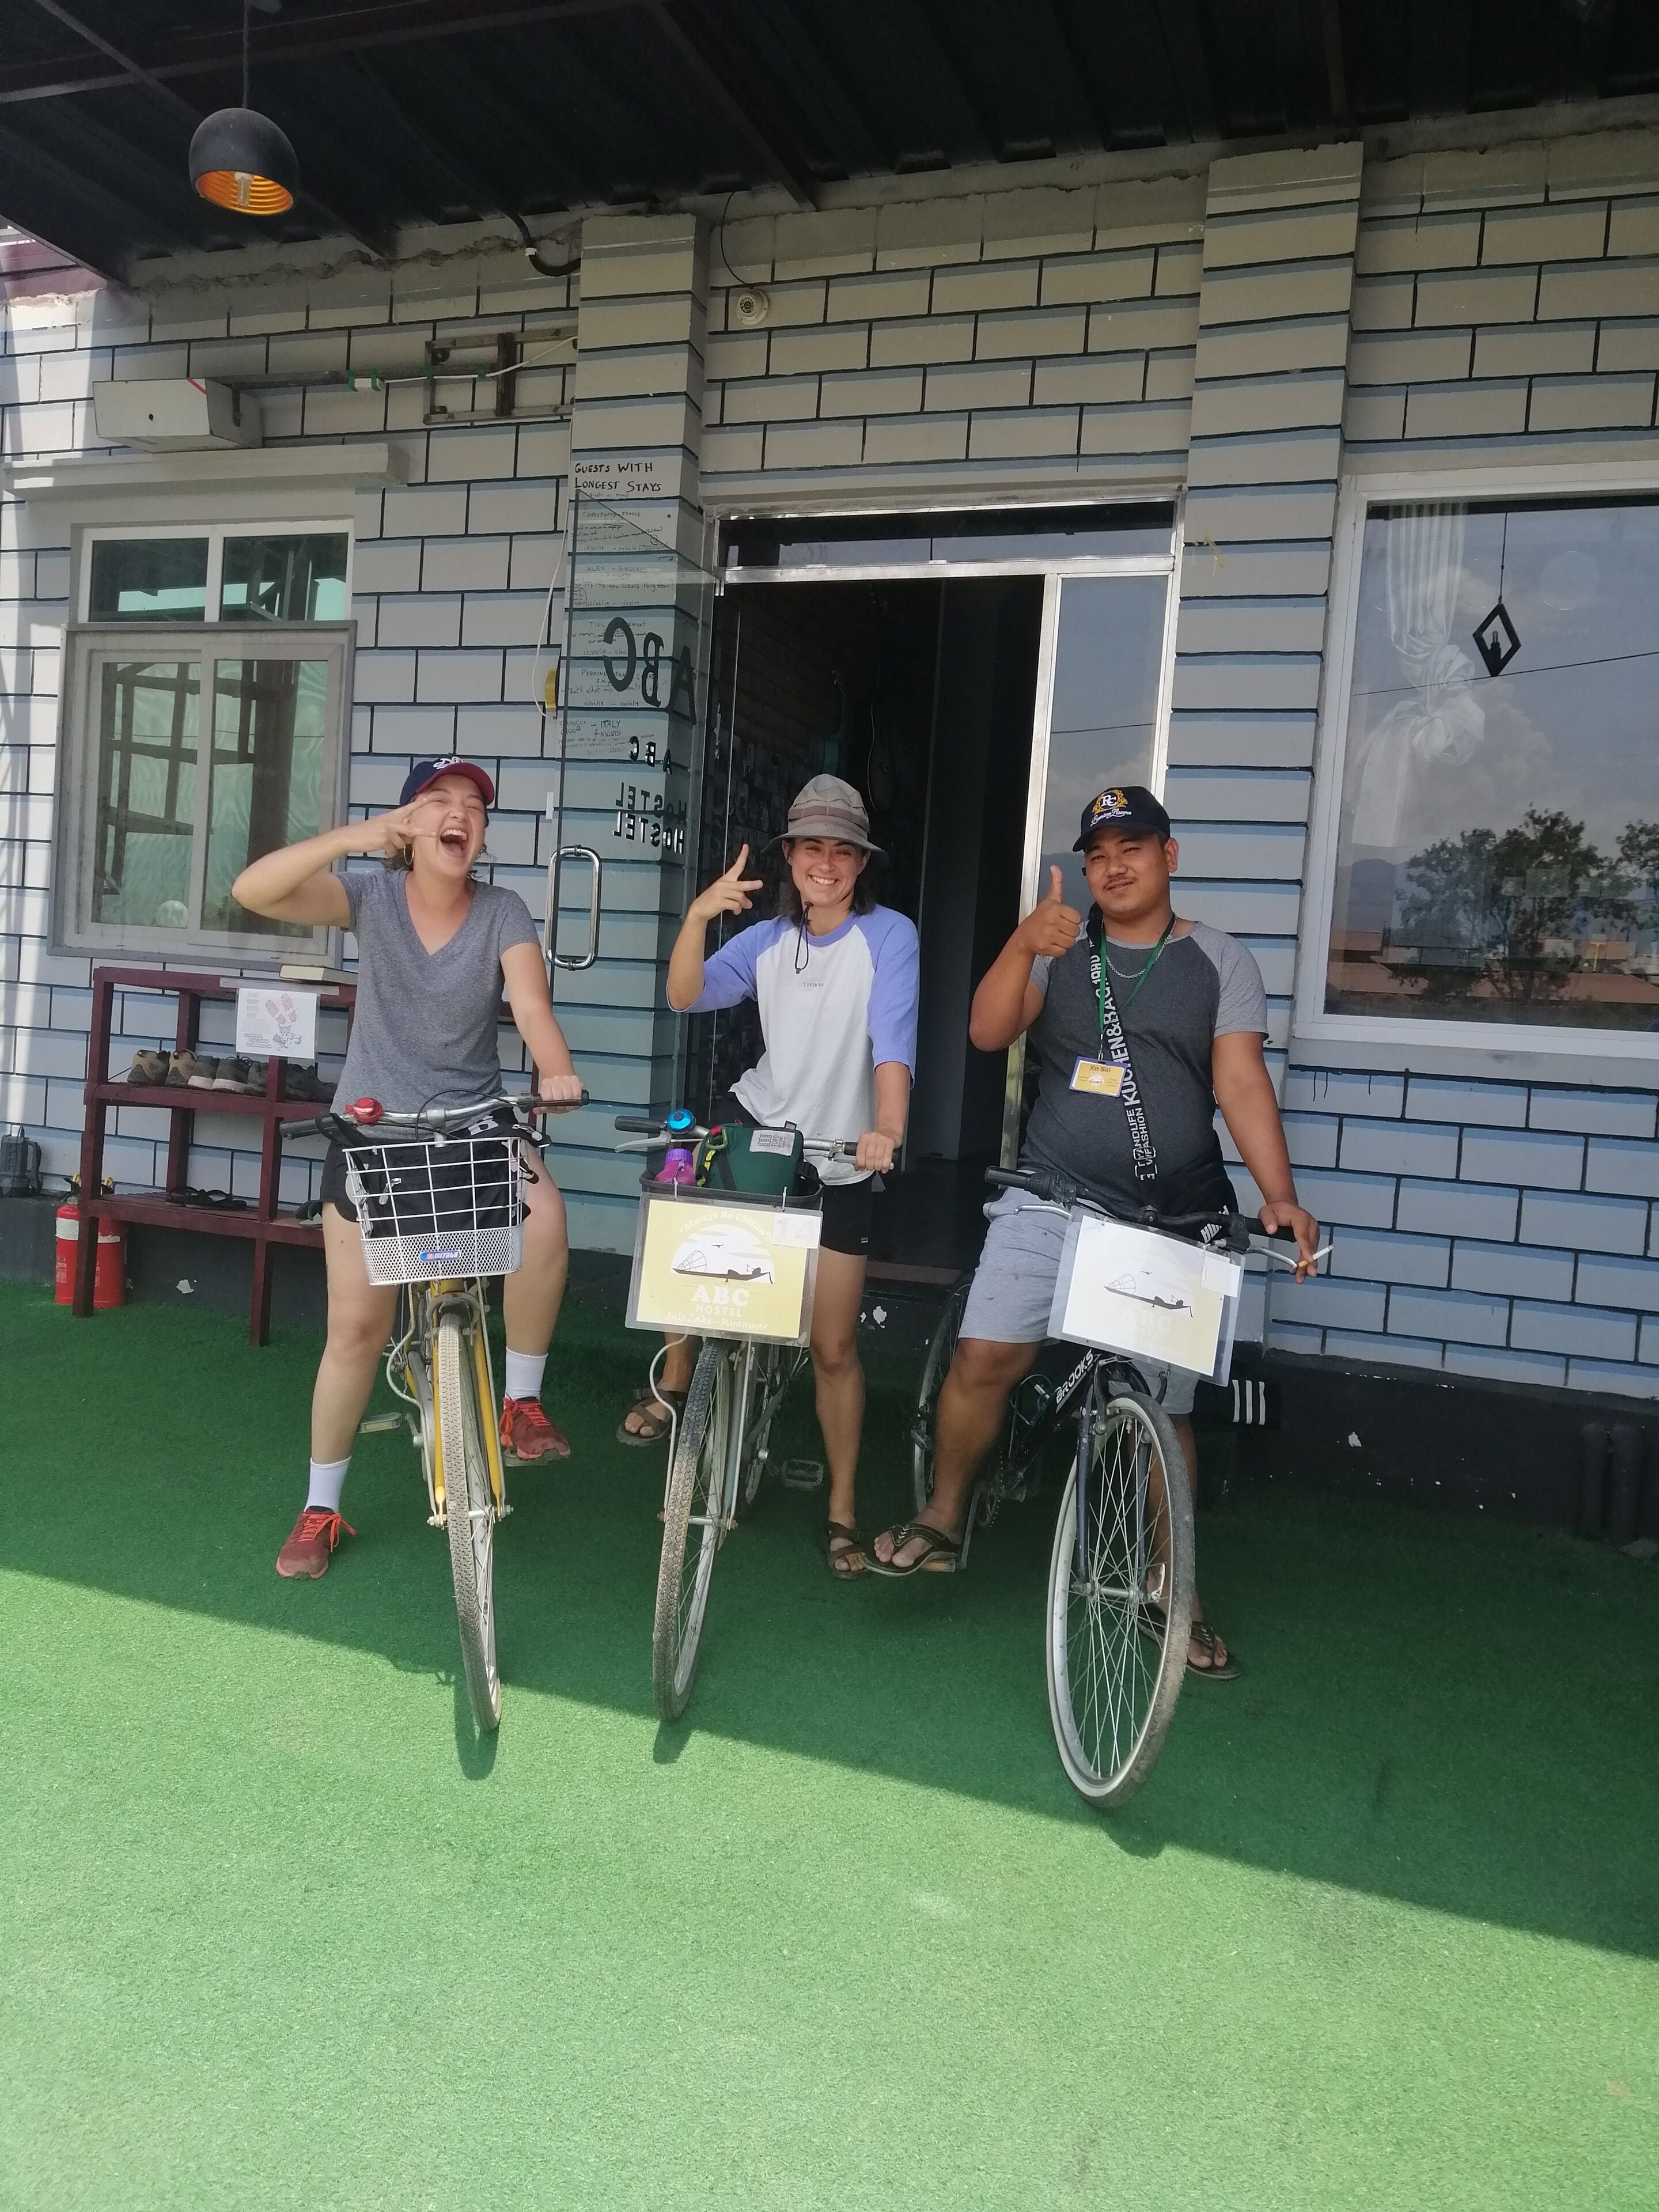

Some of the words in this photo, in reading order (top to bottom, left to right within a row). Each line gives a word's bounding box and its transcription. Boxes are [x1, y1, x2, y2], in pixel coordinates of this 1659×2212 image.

[618, 462, 653, 473] WITH
[574, 477, 620, 490] LONGEST
[627, 480, 662, 493] STAYS
[600, 719, 622, 729] ITALY
[771, 1135, 779, 1147] TOPO
[721, 1211, 733, 1219] Be
[691, 1285, 749, 1307] ABC
[696, 1304, 742, 1317] HOSTEL
[686, 1314, 712, 1324] Lake
[720, 1318, 770, 1331] Myanmar
[1056, 1349, 1093, 1404] BROOKS
